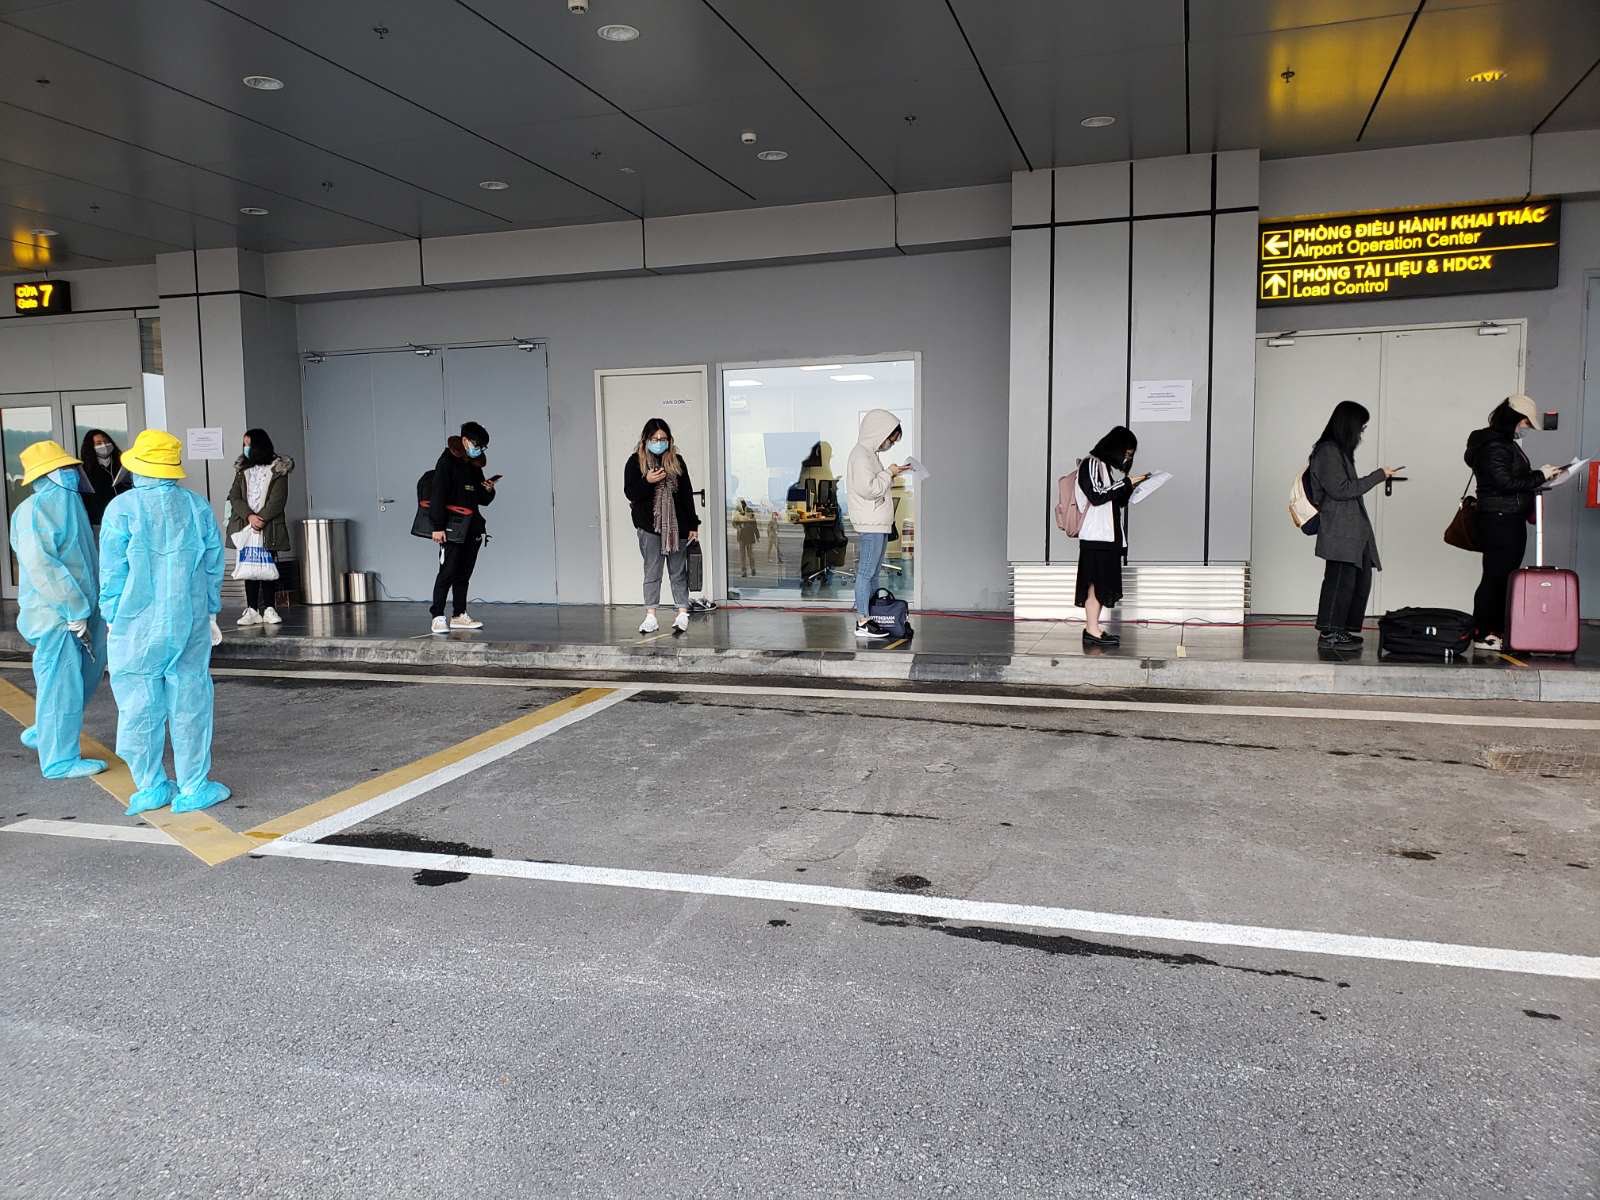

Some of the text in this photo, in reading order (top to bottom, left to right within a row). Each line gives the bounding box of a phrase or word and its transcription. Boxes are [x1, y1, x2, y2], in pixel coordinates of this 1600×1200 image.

[1293, 224, 1352, 243] PHÒNG
[1398, 215, 1447, 234] HÀNH
[1451, 212, 1494, 230] KHAI
[1497, 206, 1547, 226] THÁC
[1293, 231, 1481, 259] Airport Operation Center
[1292, 254, 1493, 283] PHÒNG TÀI LIỆU & HDCX
[39, 284, 53, 307] 7
[1293, 278, 1389, 298] Load Control
